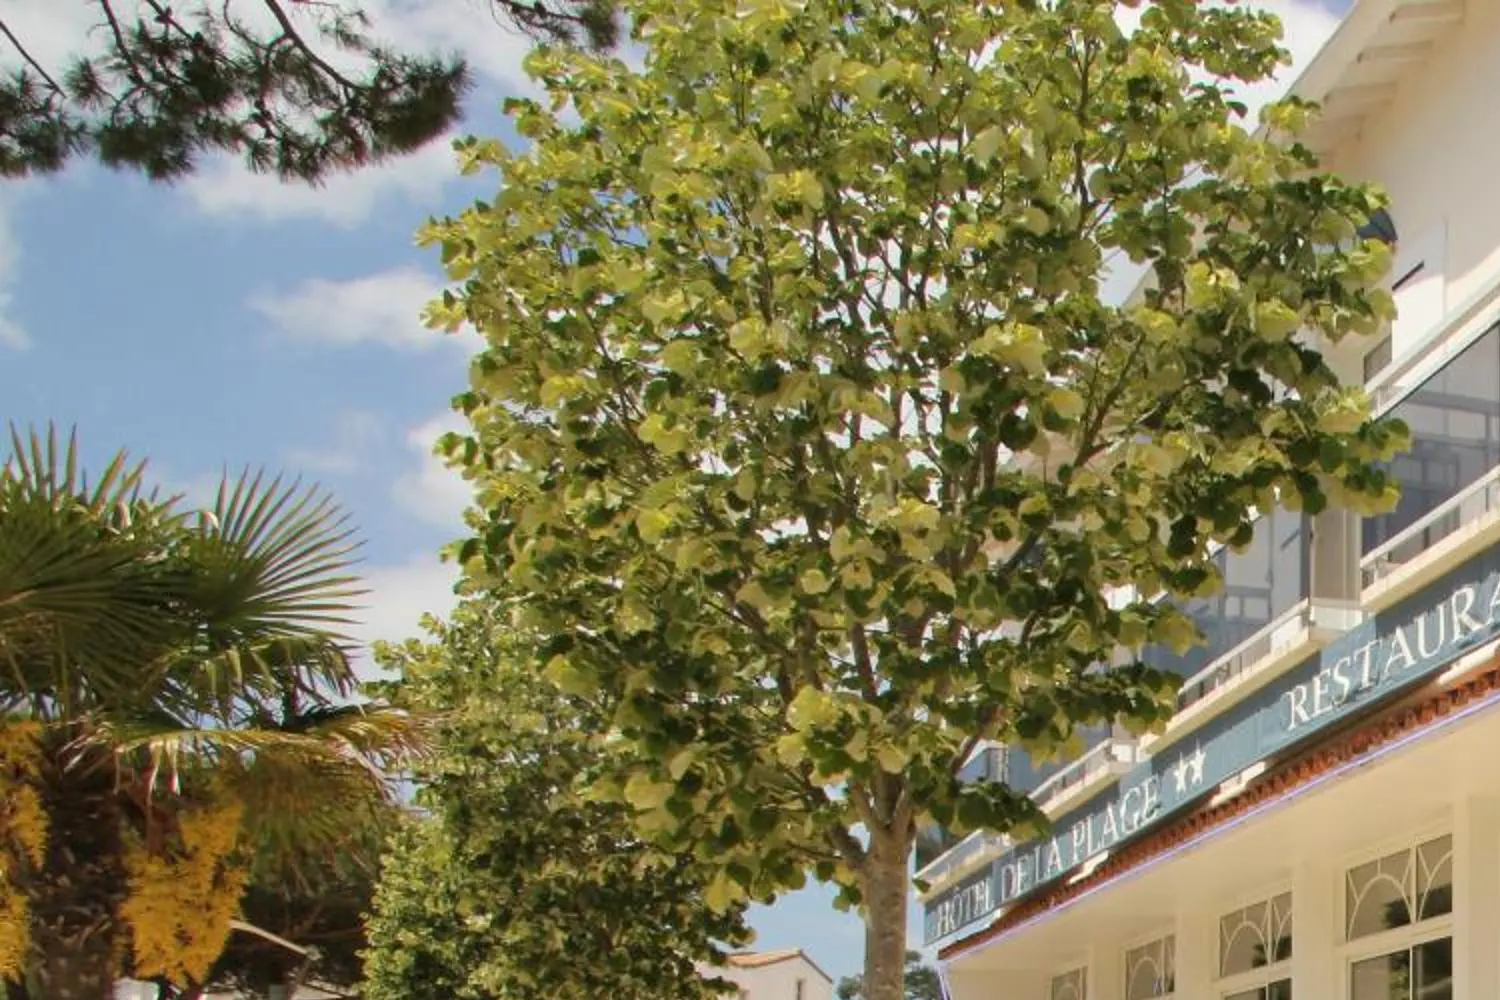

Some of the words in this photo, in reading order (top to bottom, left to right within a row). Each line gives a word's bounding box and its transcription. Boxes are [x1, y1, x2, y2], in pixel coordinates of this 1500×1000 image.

[1001, 855, 1029, 900] DE
[1034, 837, 1063, 882] LA
[1072, 775, 1161, 864] PLAGE
